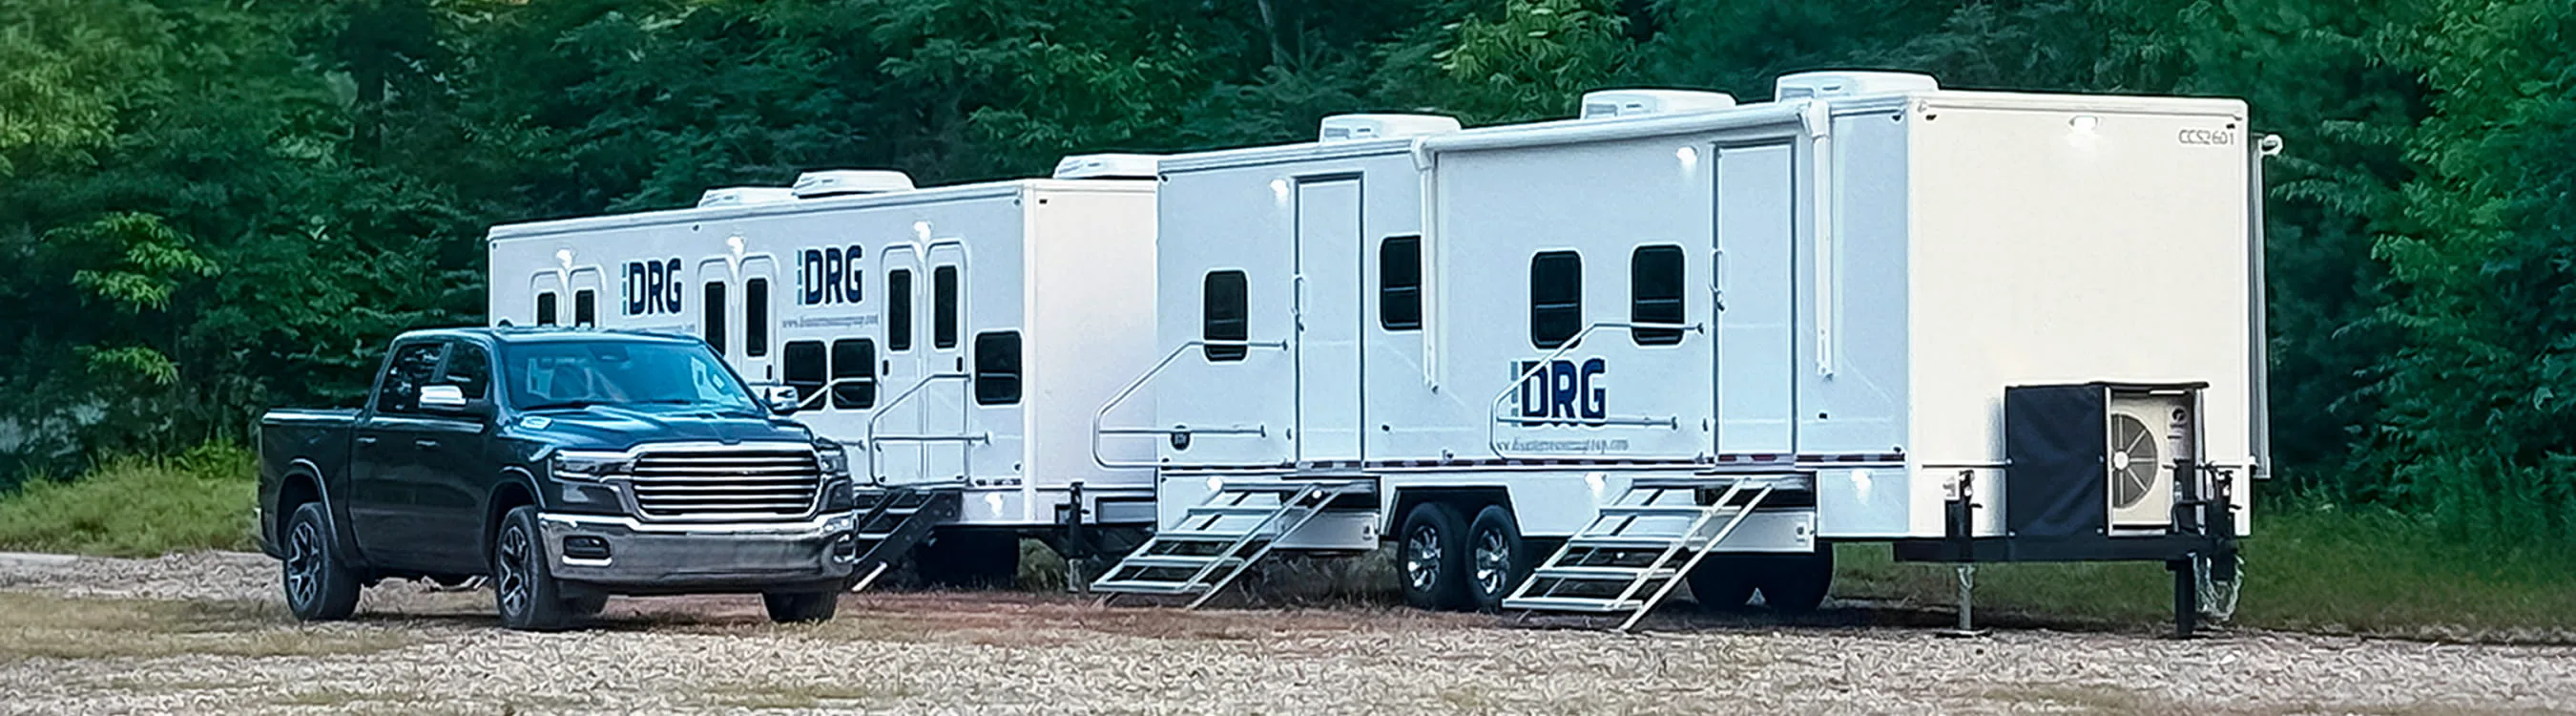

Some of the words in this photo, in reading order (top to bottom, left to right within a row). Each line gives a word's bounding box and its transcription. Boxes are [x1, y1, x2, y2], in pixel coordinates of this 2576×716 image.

[629, 257, 682, 315] DRG
[805, 244, 863, 305] DRG
[1521, 358, 1607, 427] DRG
